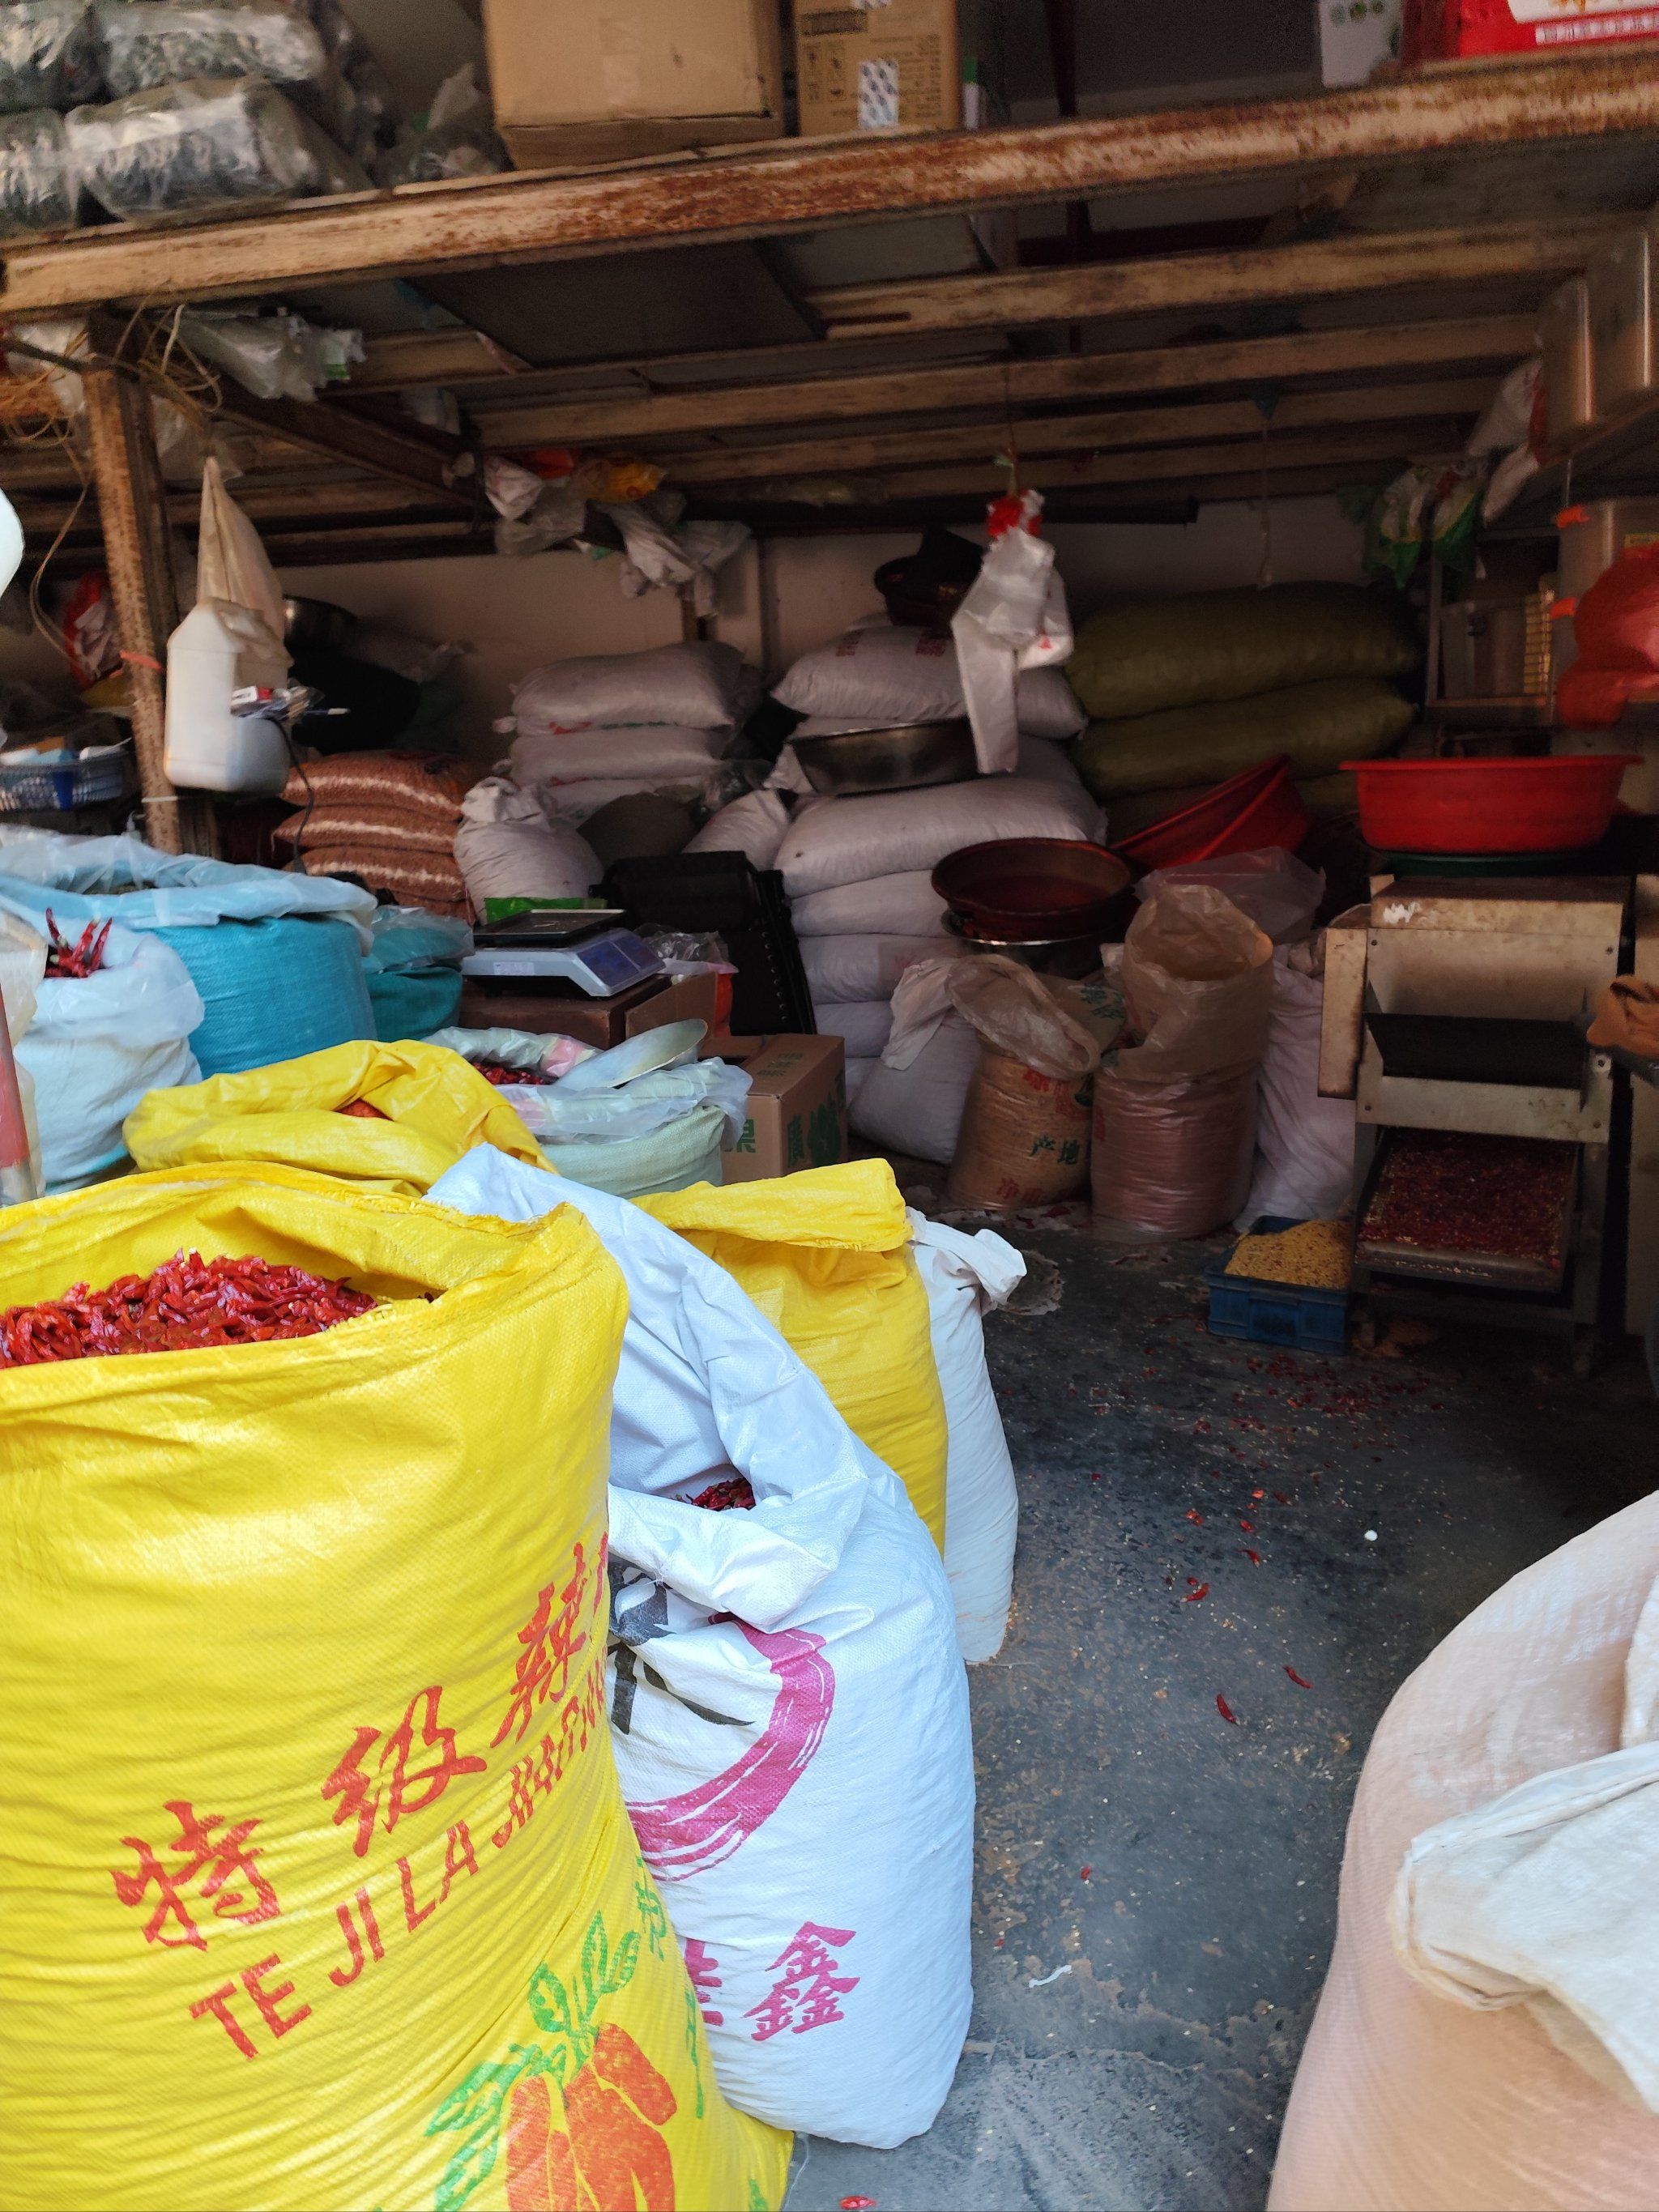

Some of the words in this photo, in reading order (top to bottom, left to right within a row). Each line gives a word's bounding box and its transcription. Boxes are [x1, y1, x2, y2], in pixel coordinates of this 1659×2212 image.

[111, 1532, 608, 1950] 特级辣
[190, 1954, 313, 2061] TE
[327, 1888, 386, 1988] JI
[395, 1819, 481, 1934] LA
